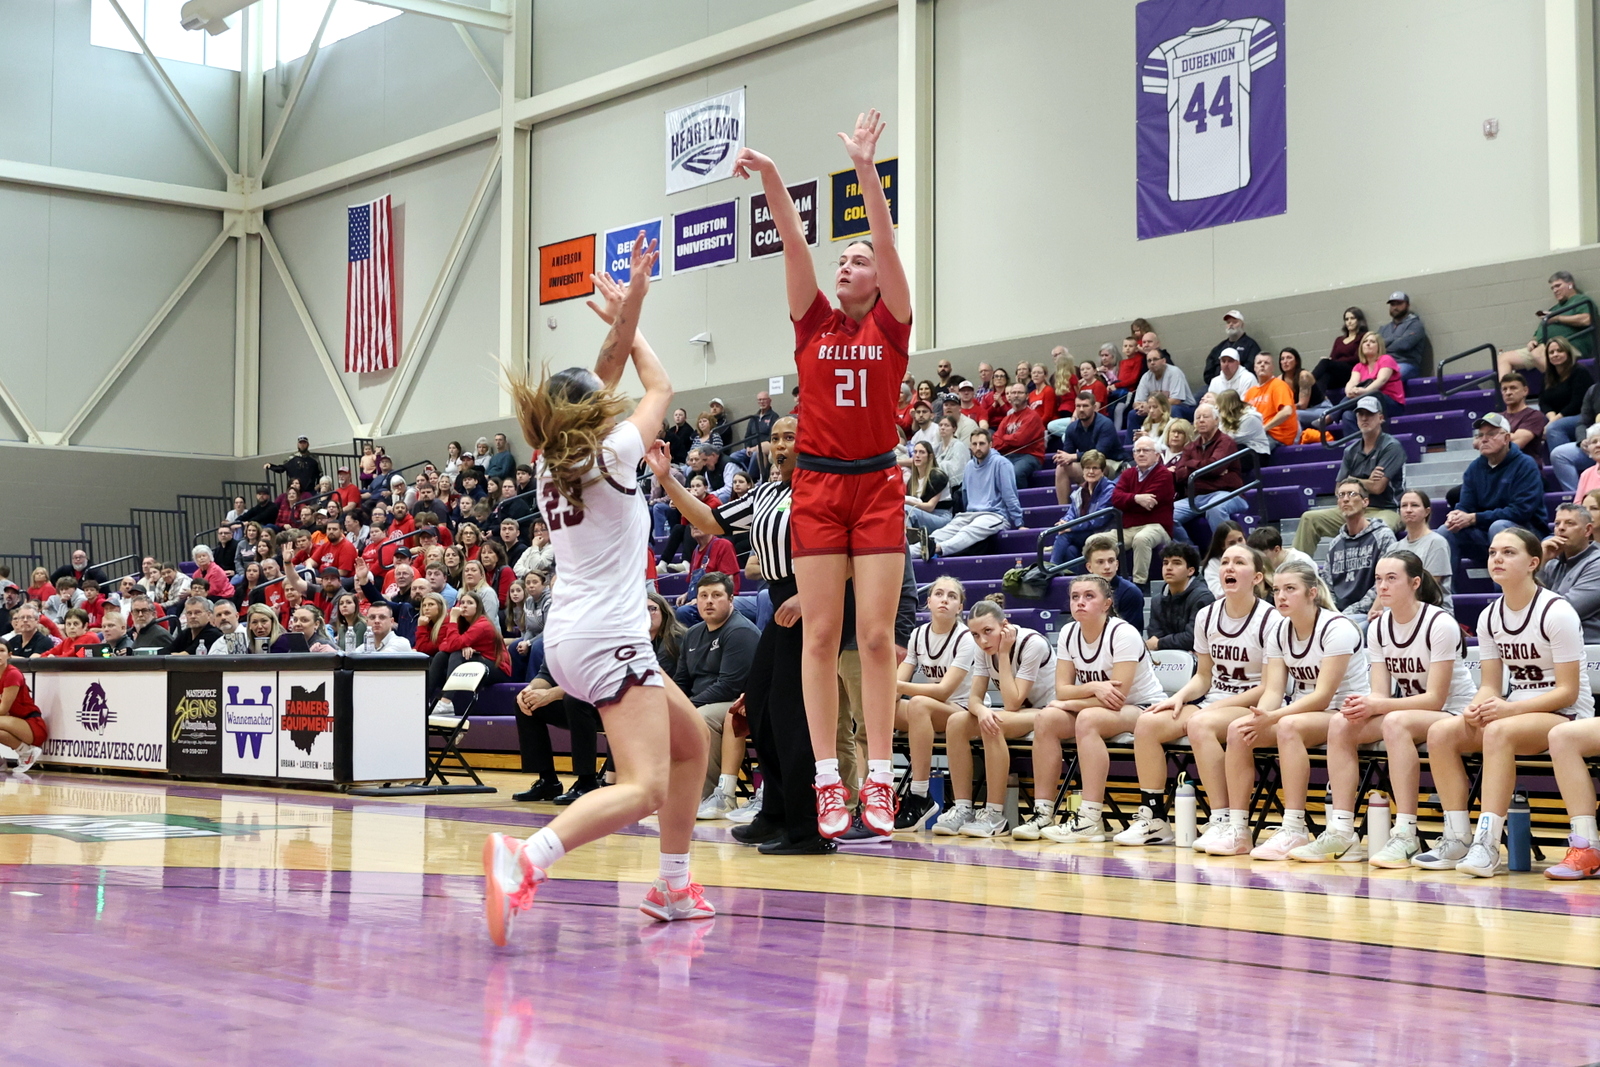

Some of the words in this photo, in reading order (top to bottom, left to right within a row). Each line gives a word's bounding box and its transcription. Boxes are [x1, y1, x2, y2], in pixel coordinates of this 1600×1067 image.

[1181, 46, 1236, 73] DUBENION
[1183, 75, 1233, 134] 44
[671, 117, 739, 161] HEARTLAND
[846, 175, 891, 198] FRAIN
[755, 195, 812, 223] EAAM
[683, 217, 727, 239] BLUFFTON
[755, 220, 809, 247] COLE
[677, 233, 733, 257] UNIVERSITY
[552, 252, 581, 268] ANDERSON
[549, 272, 583, 288] UNIVERSITY
[817, 345, 883, 361] BELLEVUE
[834, 368, 868, 407] 21
[614, 645, 637, 661] G
[1211, 643, 1250, 662] GENOA
[1384, 657, 1427, 674] GENOA
[286, 700, 329, 716] FARMERS
[227, 711, 272, 726] Wannemacher
[281, 715, 334, 732] EQUIPMENT
[42, 739, 163, 763] LUFFTONBEAVERS.COM
[300, 760, 319, 769] LAKEVIEW
